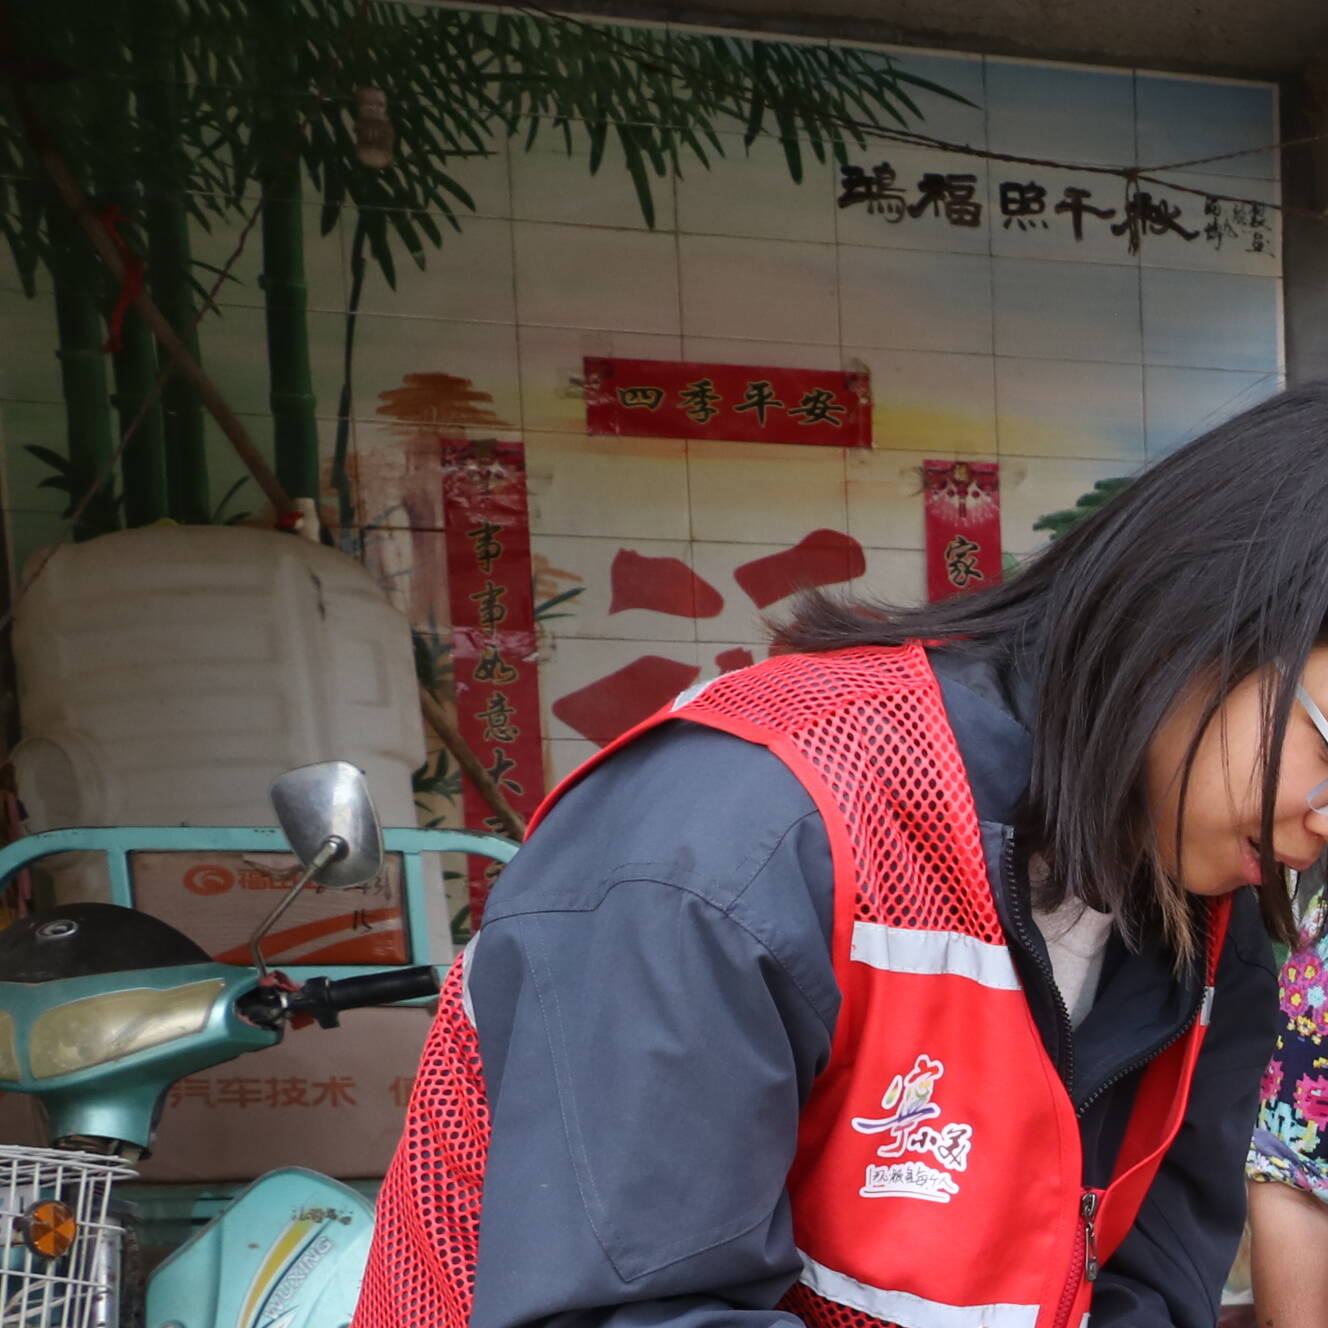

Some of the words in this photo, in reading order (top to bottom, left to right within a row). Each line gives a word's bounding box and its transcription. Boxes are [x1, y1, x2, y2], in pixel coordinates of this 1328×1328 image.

[616, 378, 847, 428] 四季平安
[944, 534, 984, 587] 家
[263, 1236, 332, 1319] WUXING
